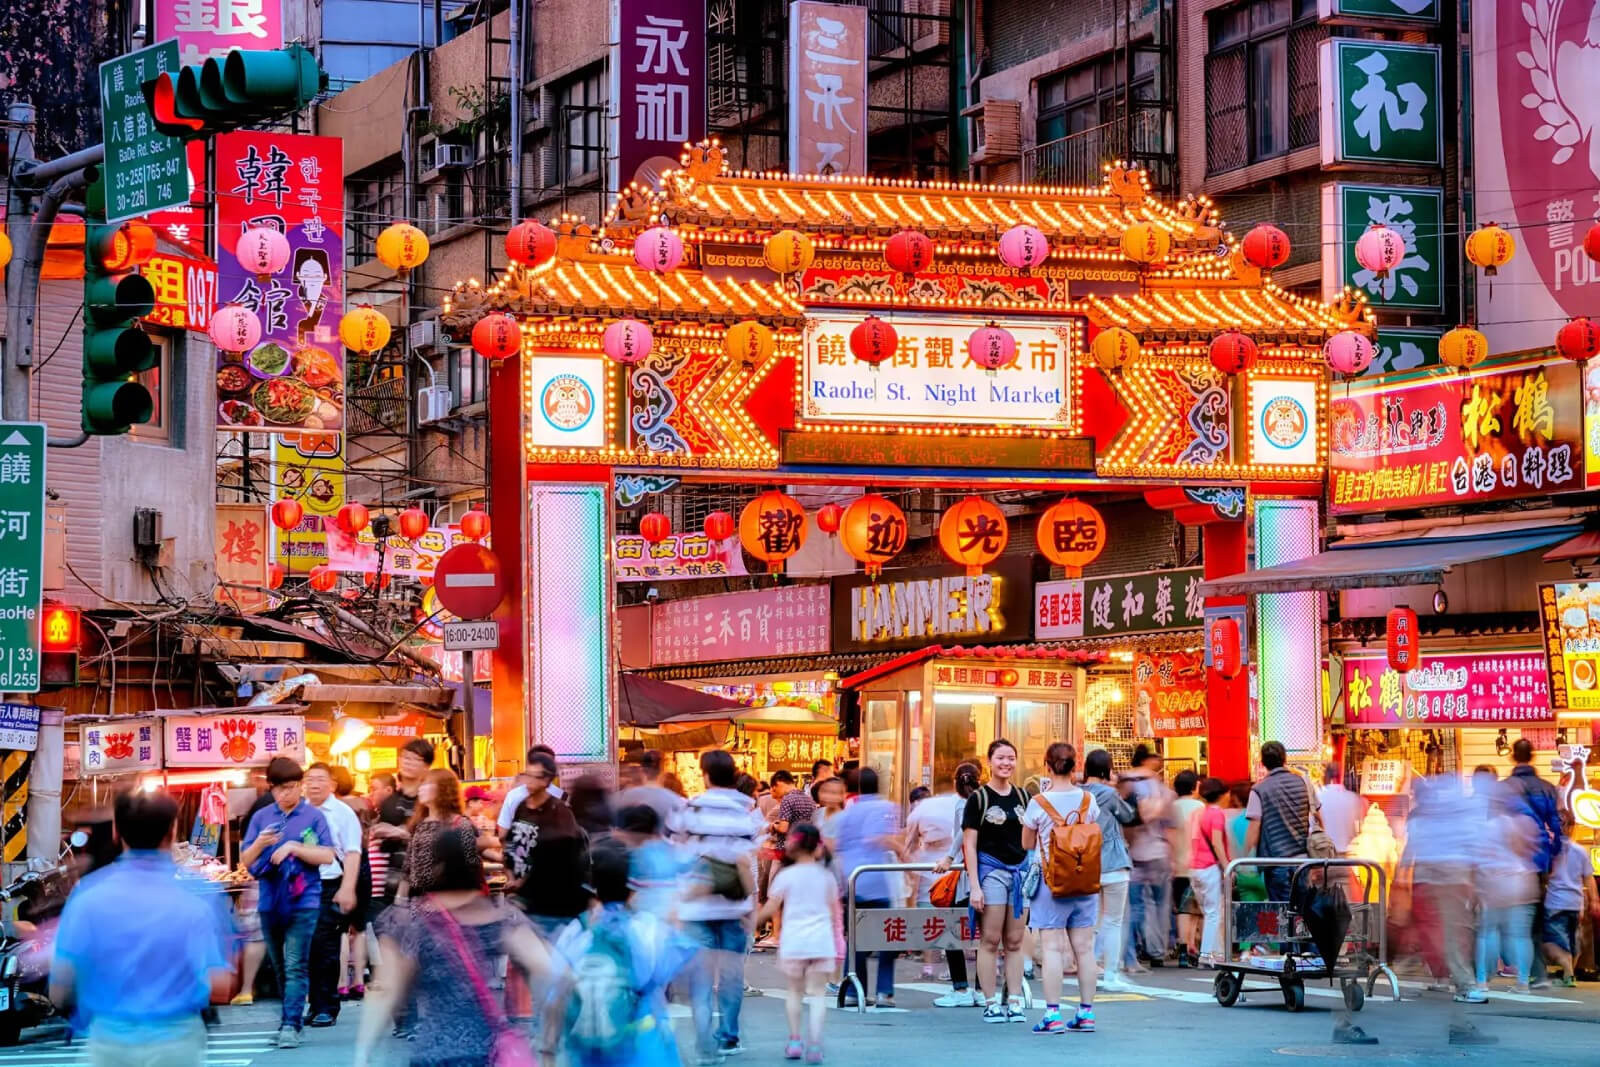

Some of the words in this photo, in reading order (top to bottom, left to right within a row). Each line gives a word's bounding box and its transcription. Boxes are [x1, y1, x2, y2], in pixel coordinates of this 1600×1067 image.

[636, 15, 690, 142] 永和
[116, 167, 144, 190] 33-255
[146, 157, 180, 183] 765-847
[119, 147, 136, 163] BaDe
[116, 189, 145, 212] 30-226
[156, 182, 172, 201] 746
[297, 156, 322, 243] 한국관
[231, 144, 293, 335] 韓館
[258, 233, 268, 268] 天上聖母
[816, 332, 1058, 373] 饒街觀市
[813, 380, 874, 400] Raohe
[887, 382, 911, 401] St.
[924, 383, 977, 407] Night
[991, 384, 1062, 405] Market
[1463, 372, 1554, 448] 松鶴
[1452, 446, 1572, 495] 台港日料理
[0, 453, 31, 598] 饒河街
[758, 509, 802, 554] 歡
[866, 513, 902, 556] 迎
[959, 514, 1002, 554] 光
[1054, 517, 1097, 552] 臨
[394, 553, 438, 572] 第2
[617, 535, 709, 560] 街夜市
[616, 562, 726, 577] 乃馨大放送
[702, 604, 774, 647] 三禾百貨
[851, 574, 996, 641] HAMMER
[445, 627, 496, 643] 16:00-24:00
[1028, 670, 1073, 688] 服務台
[1349, 667, 1403, 719] 松鶴
[87, 730, 100, 766] 蟹肉
